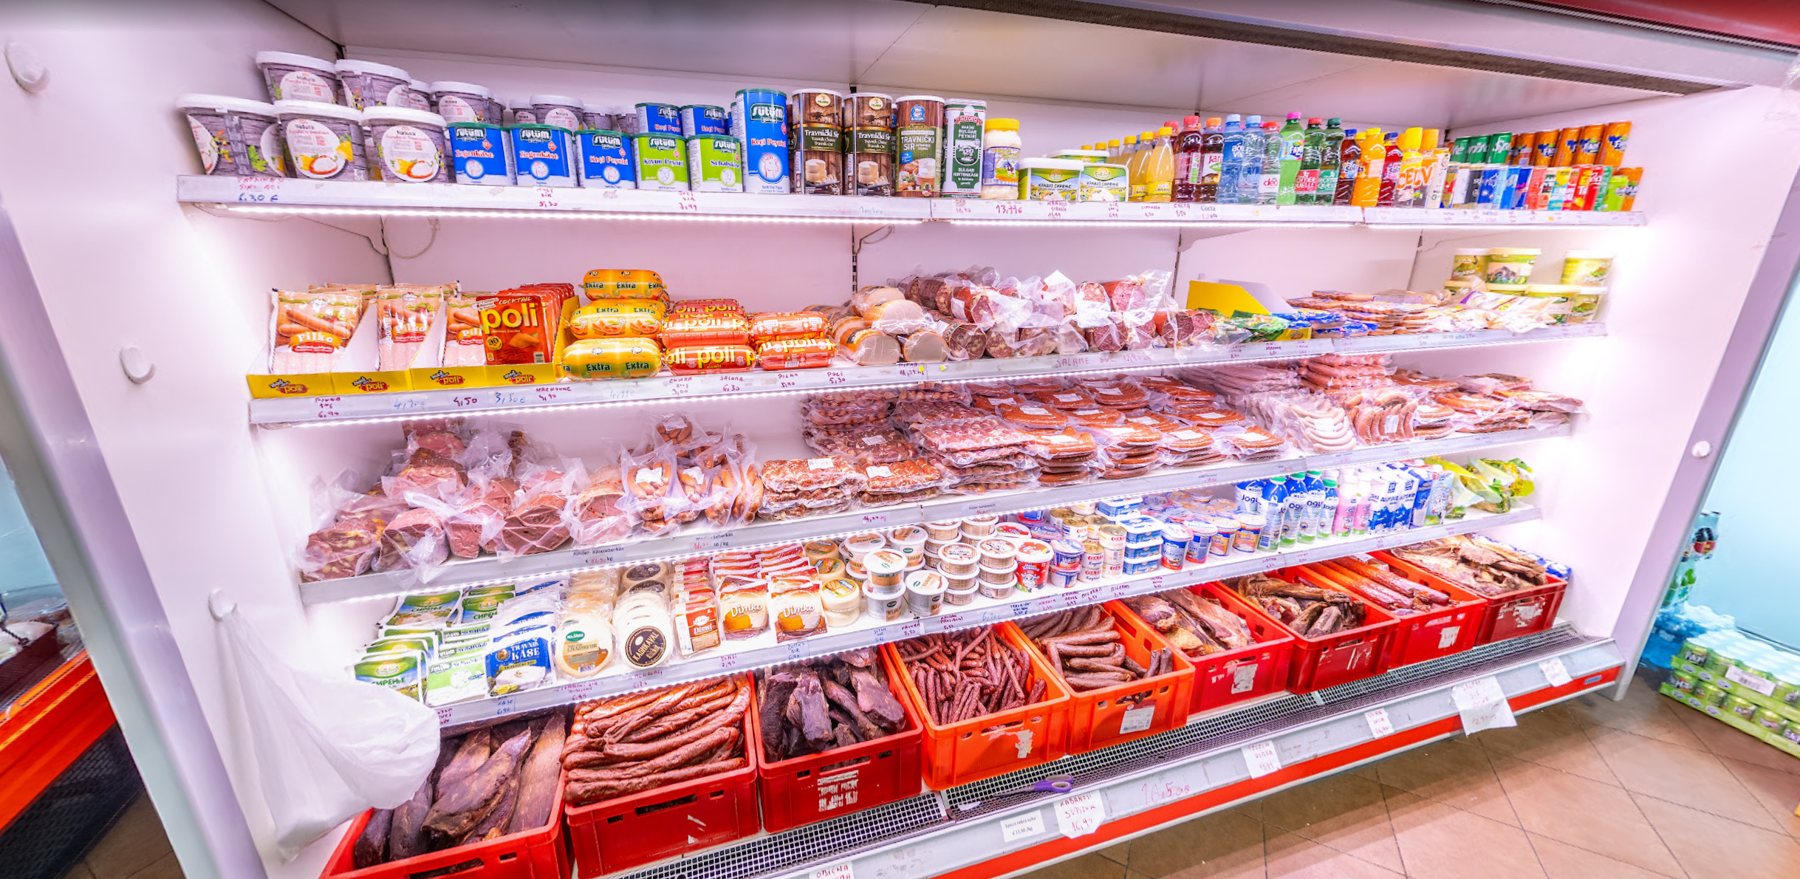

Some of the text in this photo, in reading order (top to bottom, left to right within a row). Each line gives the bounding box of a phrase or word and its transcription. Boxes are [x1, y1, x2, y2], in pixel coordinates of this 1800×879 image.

[901, 135, 935, 144] TRAVNIČKI
[903, 143, 915, 151] SIR
[480, 303, 538, 335] poli
[698, 346, 736, 369] poli
[586, 362, 650, 371] Extra Extra
